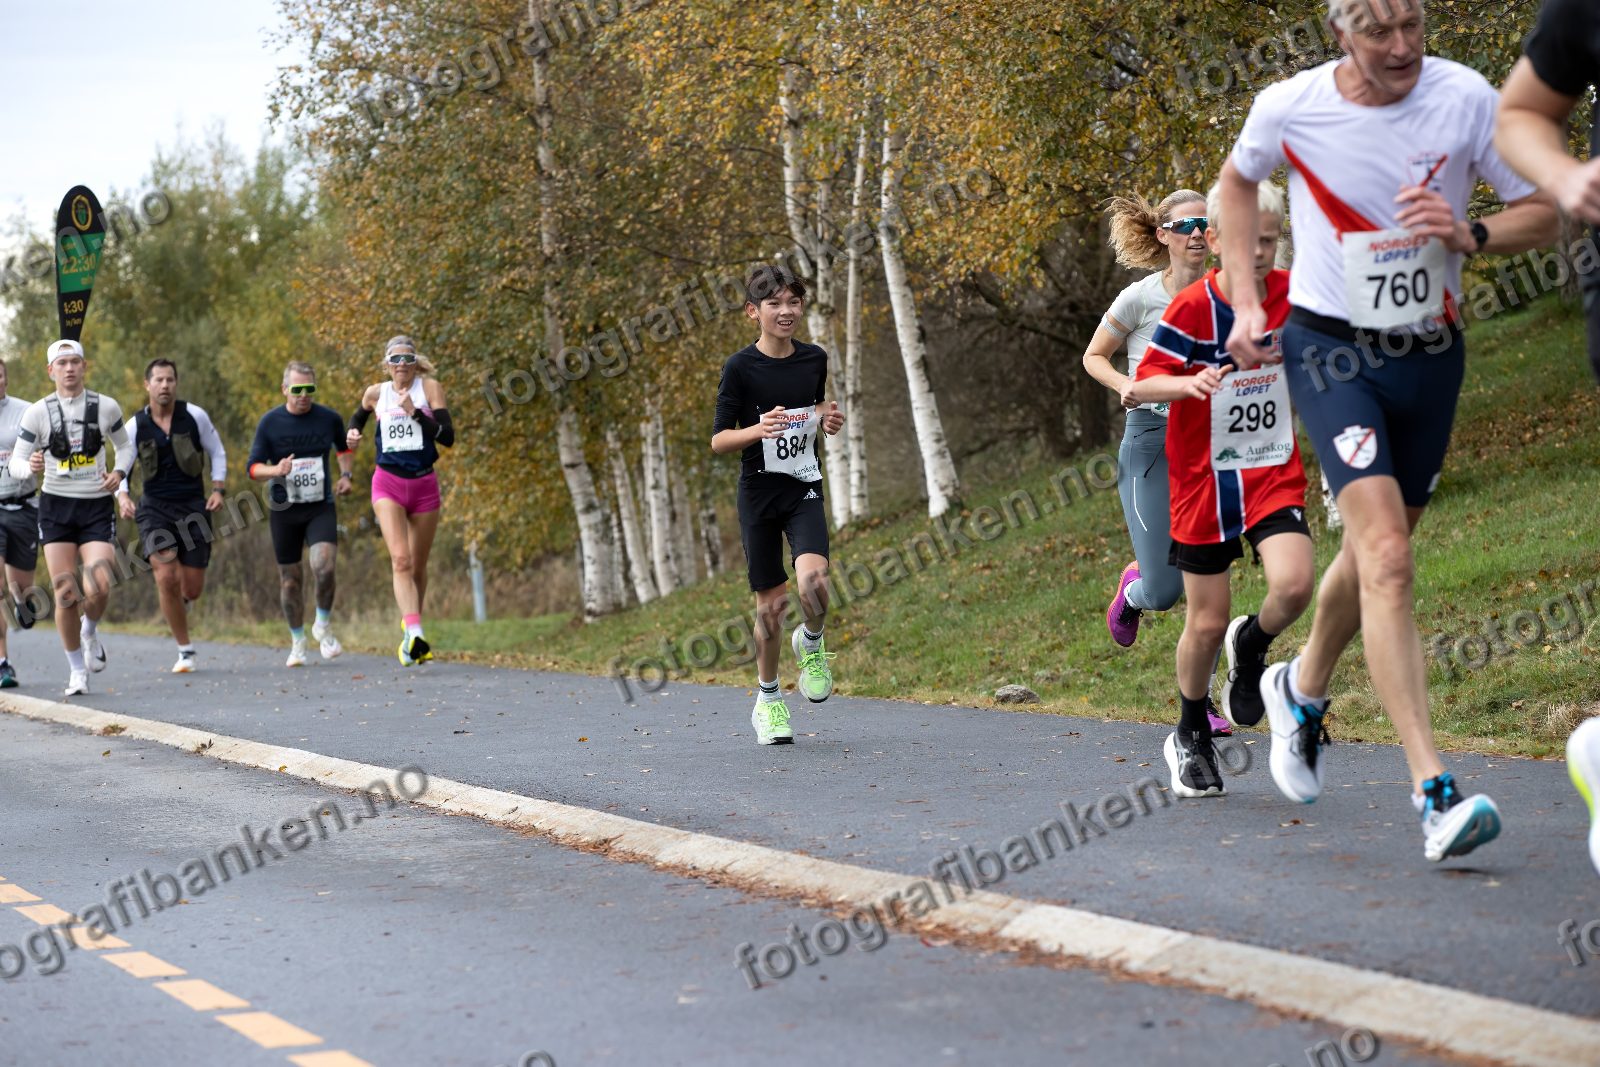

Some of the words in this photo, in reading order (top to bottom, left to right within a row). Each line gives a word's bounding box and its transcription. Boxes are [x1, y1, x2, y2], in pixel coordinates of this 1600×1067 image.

[1367, 268, 1429, 309] 760
[1232, 373, 1278, 388] NORGES
[1236, 384, 1271, 396] LØPET
[1228, 400, 1276, 433] 298
[389, 424, 413, 439] 894
[776, 434, 807, 460] 884
[1246, 442, 1292, 456] Aurskog
[294, 473, 317, 487] 885
